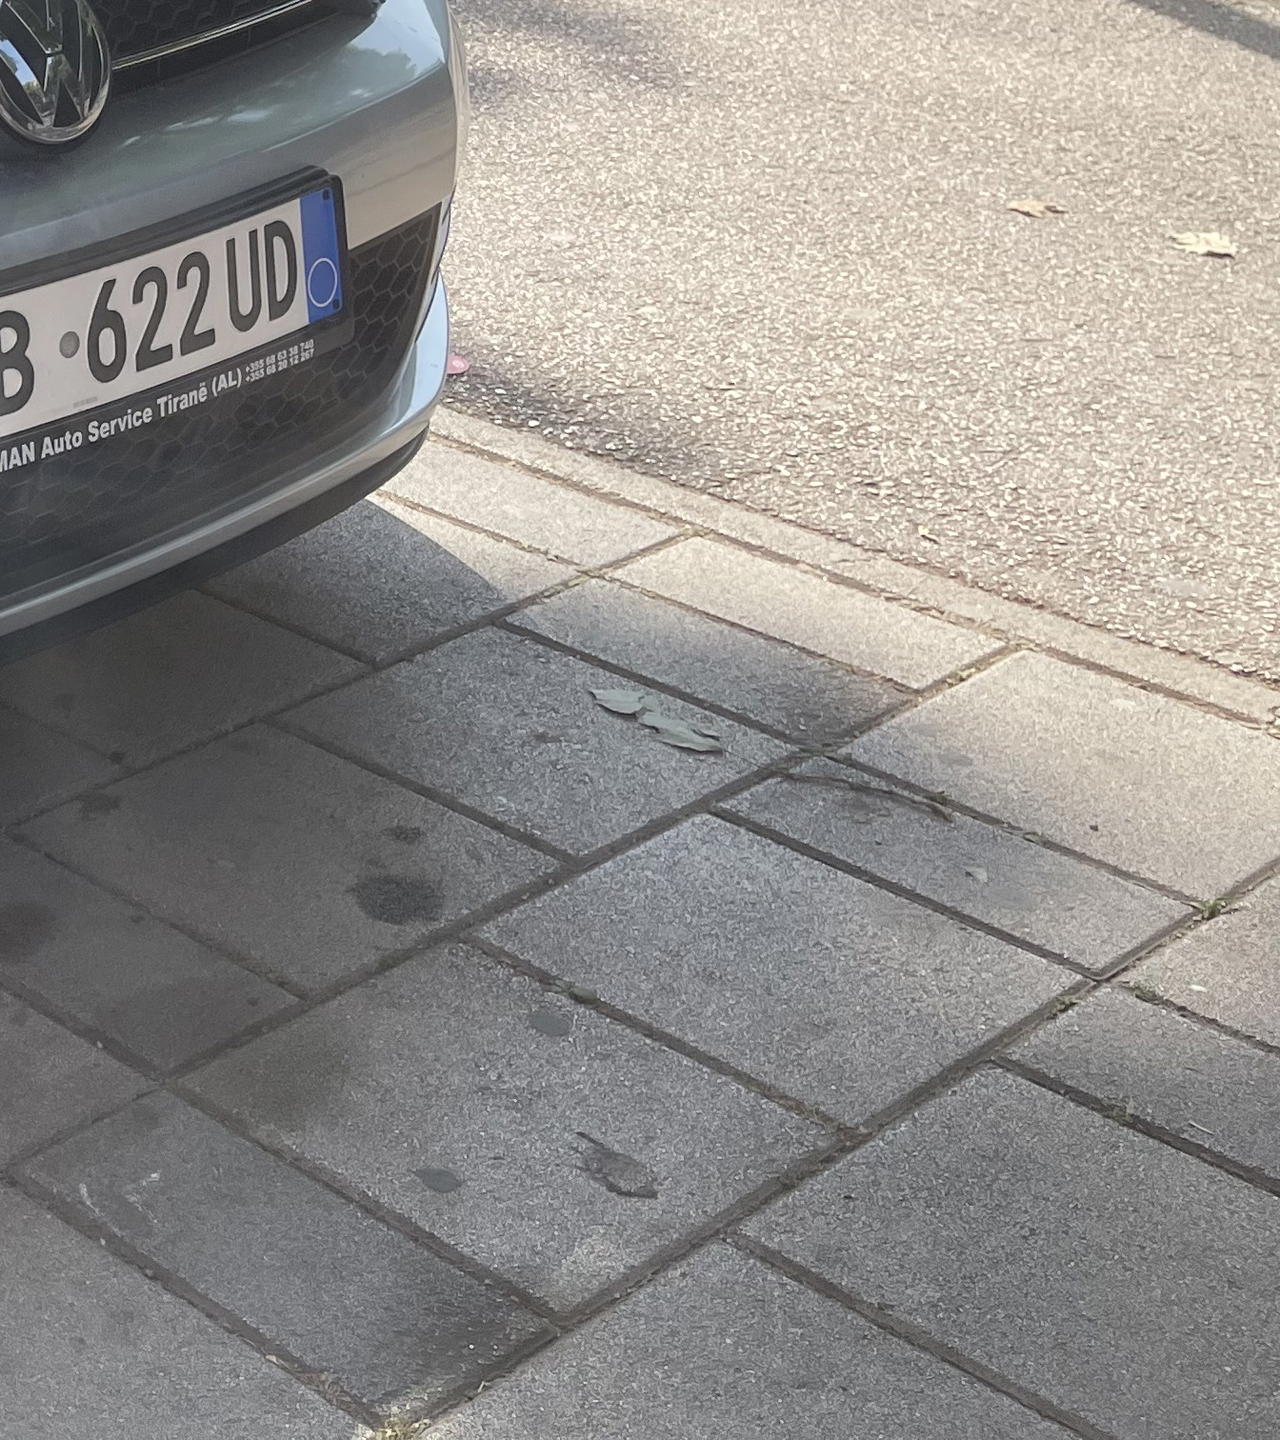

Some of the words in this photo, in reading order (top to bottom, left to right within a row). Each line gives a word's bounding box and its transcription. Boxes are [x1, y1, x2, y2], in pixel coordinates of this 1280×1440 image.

[86, 252, 216, 383] 622
[226, 220, 297, 332] UD
[245, 359, 264, 372] +355
[277, 350, 287, 360] 63
[245, 368, 264, 382] +355
[277, 360, 288, 371] 20
[289, 355, 299, 366] 12
[300, 348, 314, 362] 267
[41, 429, 83, 459] Auto
[88, 406, 153, 443] Service
[157, 383, 208, 417] Tiranë
[211, 368, 242, 397] (AL)
